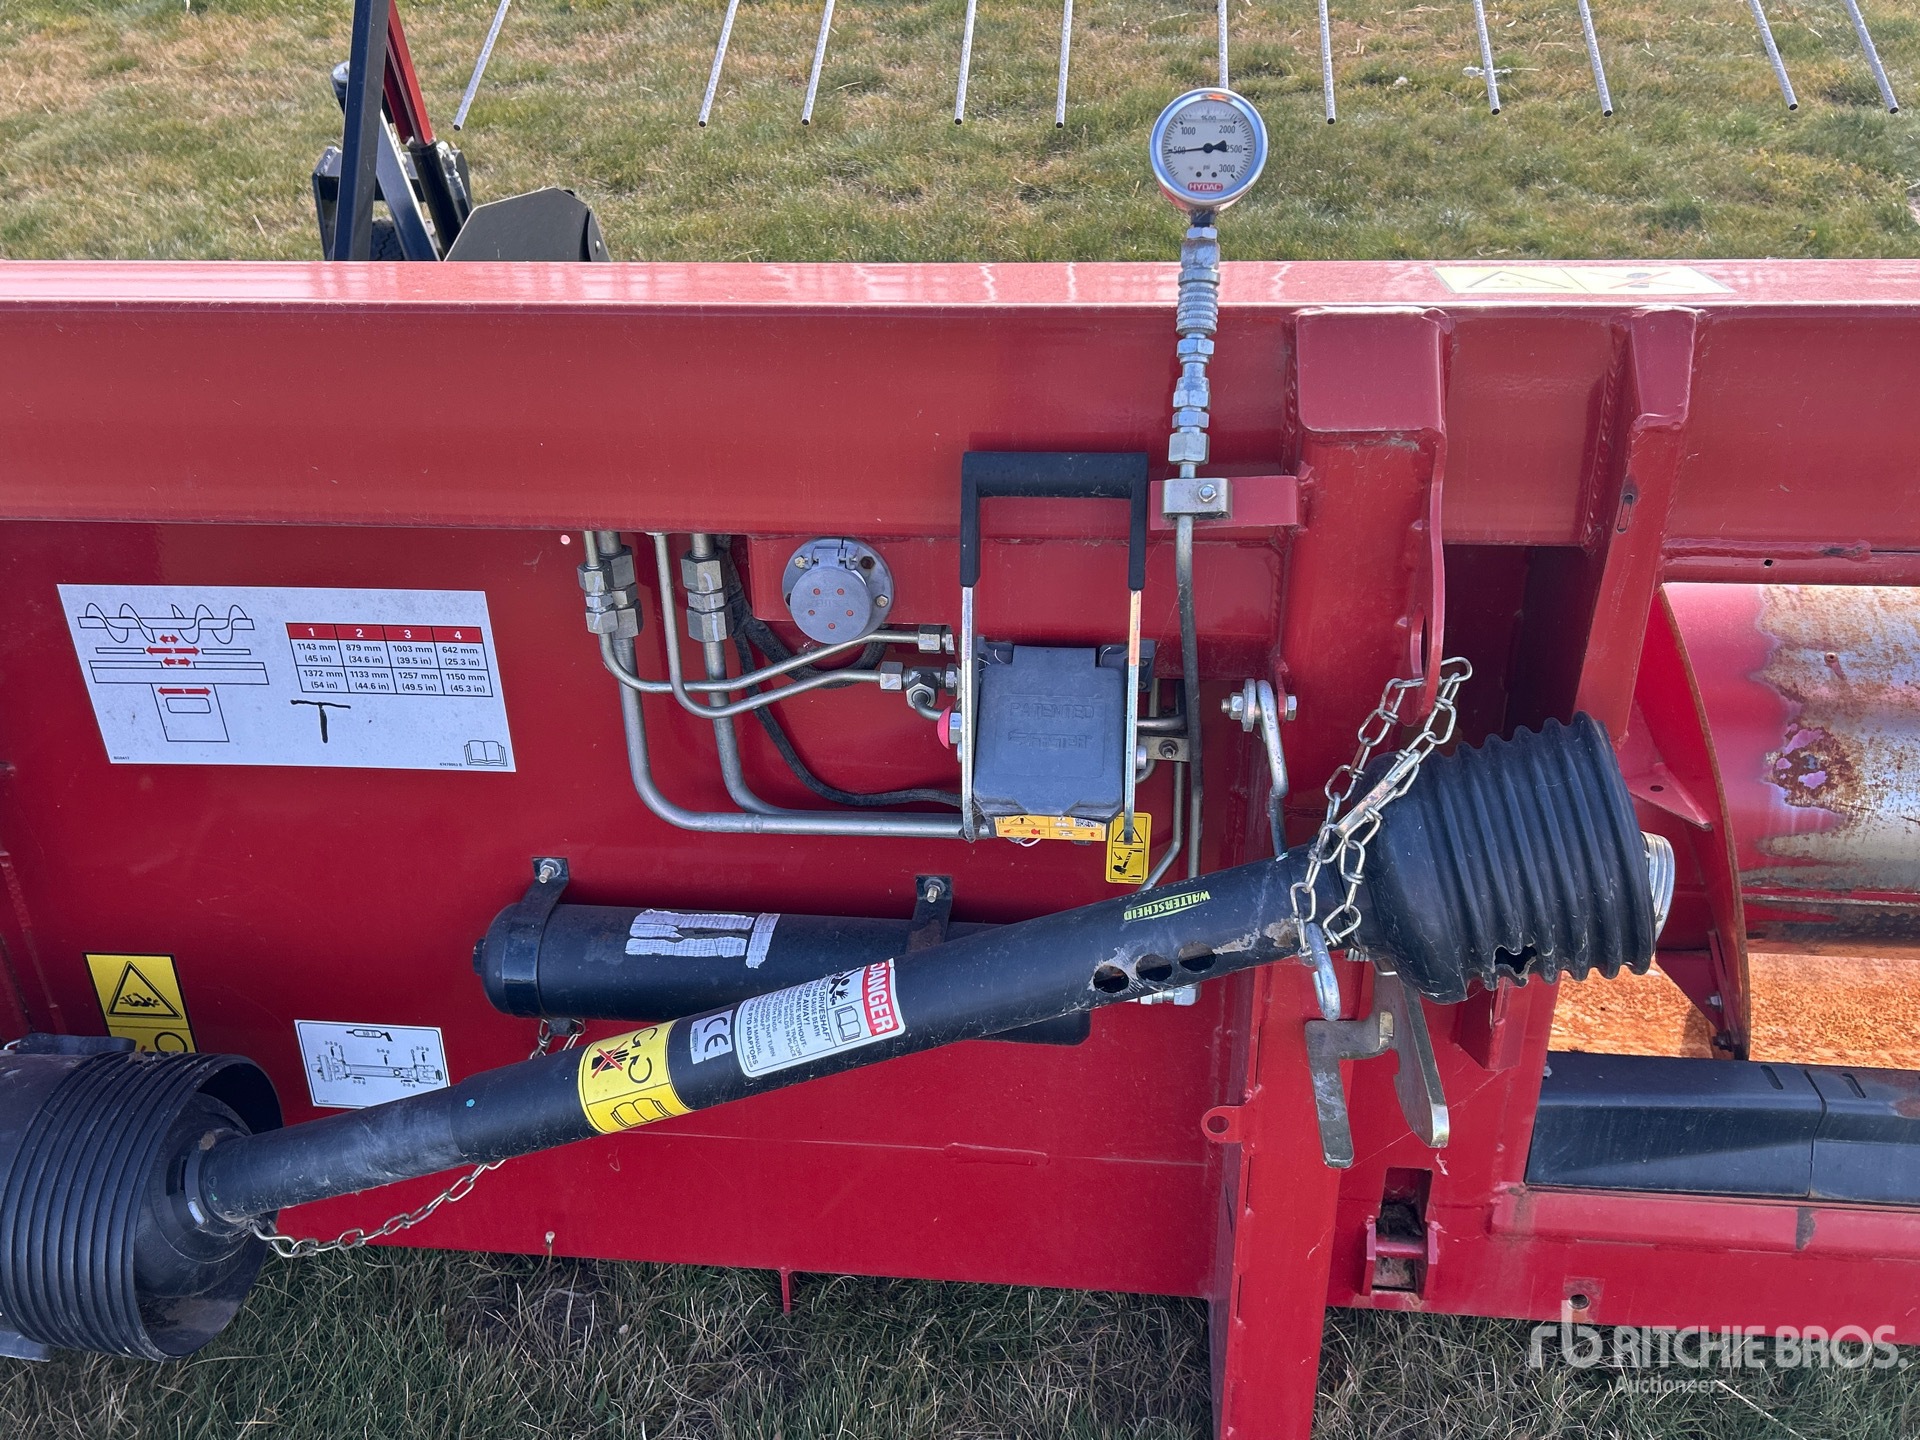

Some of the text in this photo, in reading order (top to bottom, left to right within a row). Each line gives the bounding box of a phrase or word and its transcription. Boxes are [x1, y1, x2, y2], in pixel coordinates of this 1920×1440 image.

[1181, 127, 1196, 135] 1000
[1219, 125, 1235, 134] 2000
[1174, 146, 1185, 154] 500
[1219, 164, 1235, 172] 3000
[1189, 183, 1222, 191] HYDAC
[308, 628, 315, 637] 1
[356, 629, 363, 637] 2
[404, 630, 411, 639] 3
[454, 631, 462, 640] 4
[420, 657, 432, 665] in)
[445, 658, 466, 666] (25.3
[474, 685, 485, 693] in)
[1010, 702, 1094, 719] PATENTED
[290, 700, 351, 743] T
[1123, 890, 1211, 921] WALTERSCHEID
[819, 991, 832, 1042] DRIVESHAFT
[796, 1013, 807, 1048] WITHOUT-
[812, 1017, 820, 1036] DEATH
[703, 1017, 728, 1052] CE
[747, 1027, 758, 1065] ADAPTORS
[754, 1030, 762, 1055] MANUAL
[768, 1040, 776, 1057] TURN
[787, 1038, 797, 1057] PLACE
[791, 1028, 802, 1056] TRACTOR
